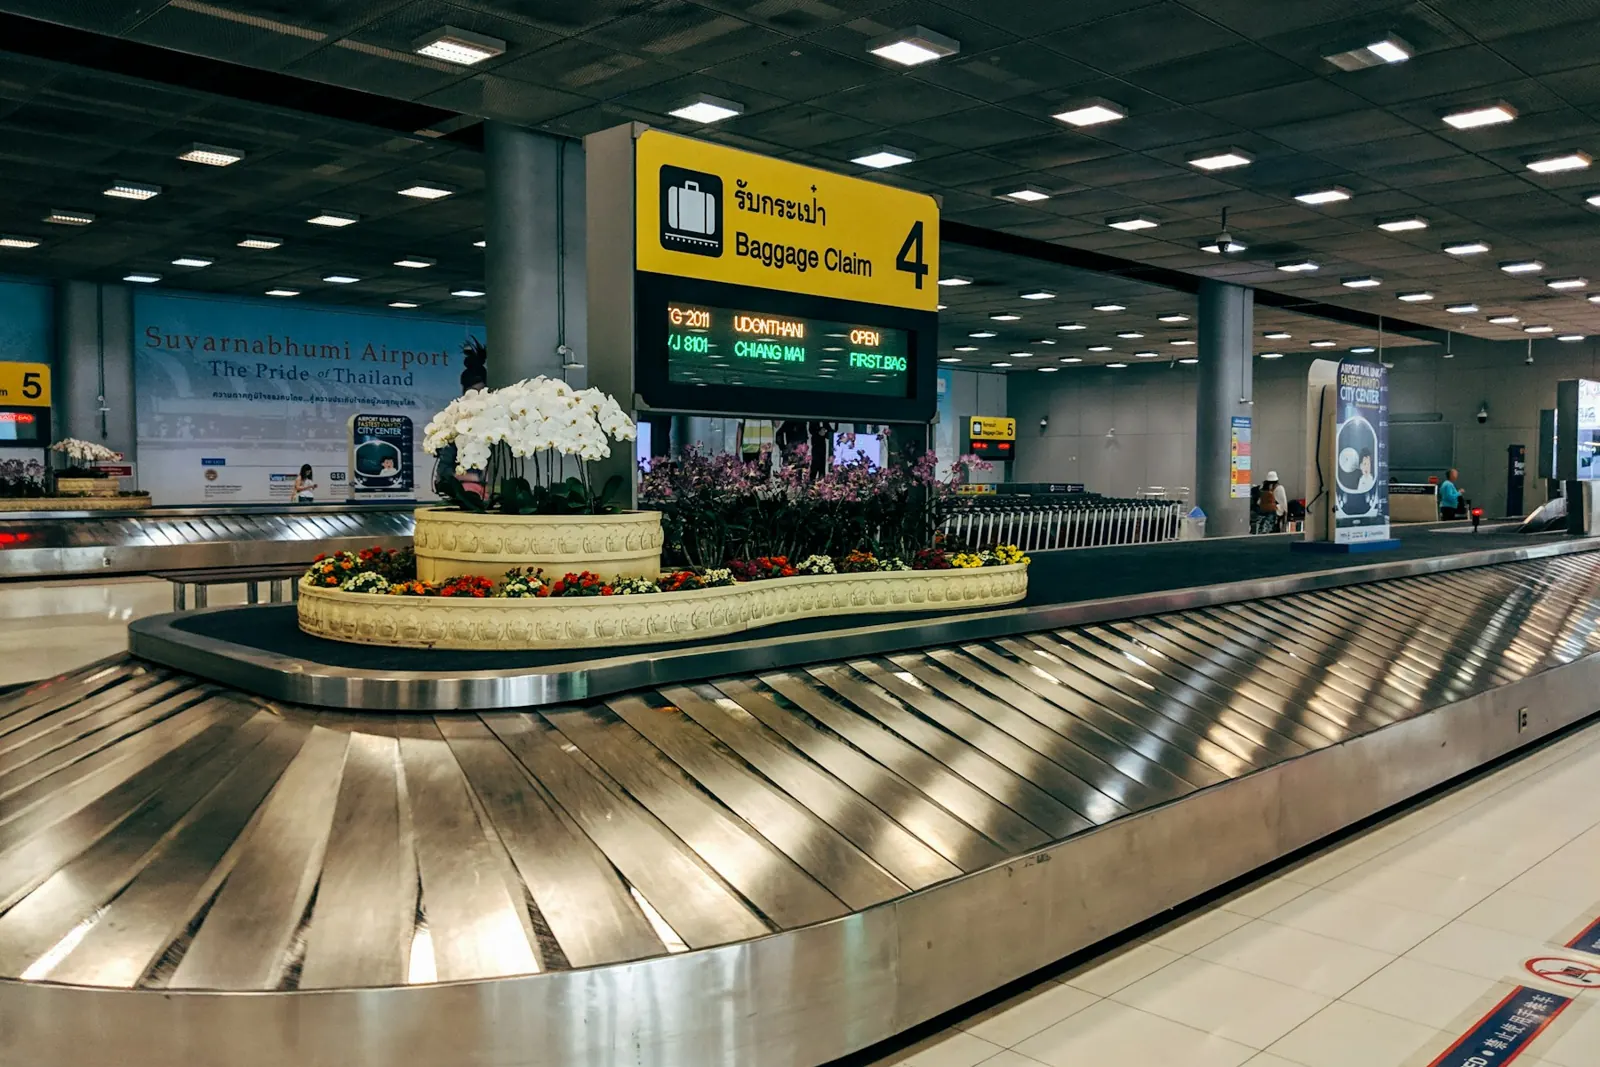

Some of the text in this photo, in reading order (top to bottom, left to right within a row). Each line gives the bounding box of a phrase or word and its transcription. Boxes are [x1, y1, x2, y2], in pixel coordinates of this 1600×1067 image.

[735, 178, 826, 226] รับกระเป๋า
[736, 231, 872, 277] Baggage Claim
[896, 220, 929, 290] 4
[667, 307, 879, 346] G 2011 UDONTHANI OPEN
[145, 325, 449, 370] Suvarnabhumi Airport
[684, 335, 708, 353] 8101
[734, 341, 782, 360] CHIANG
[784, 345, 805, 362] MAI
[850, 352, 883, 369] FIRST
[884, 355, 907, 371] BAG
[22, 372, 42, 399] 5
[208, 360, 414, 387] The Pride of Thailand
[1340, 386, 1380, 404] CITY CENTER
[374, 427, 402, 435] CENTER
[1007, 423, 1014, 436] 5
